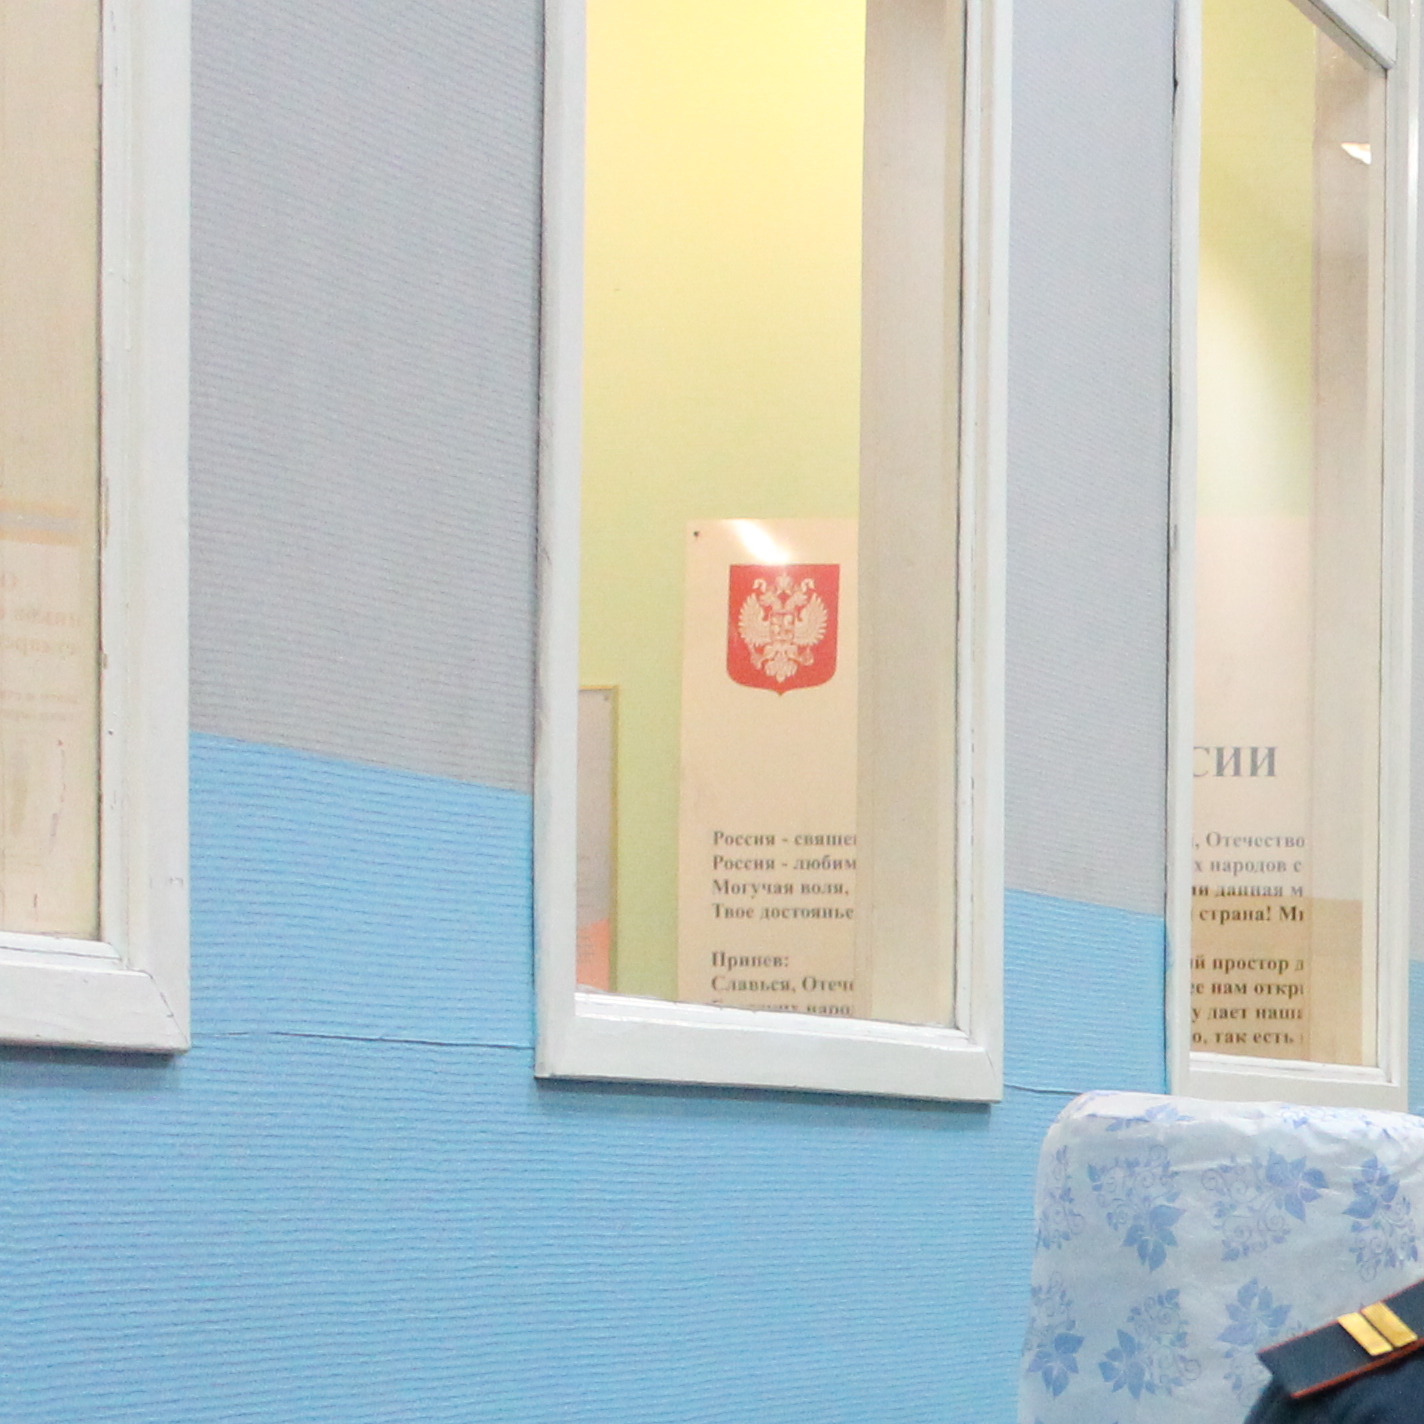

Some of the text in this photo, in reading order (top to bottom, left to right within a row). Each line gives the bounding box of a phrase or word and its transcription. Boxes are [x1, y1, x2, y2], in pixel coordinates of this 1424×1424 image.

[713, 830, 776, 846] Россия
[1205, 831, 1305, 848] Отечество
[713, 855, 775, 871] Россия
[1210, 859, 1287, 876] народов
[712, 879, 850, 899] Могучая воля,
[1215, 884, 1283, 898] данная
[712, 902, 854, 920] Твое достоянье
[1199, 906, 1271, 925] страна!
[712, 951, 789, 971] Припев:
[1213, 958, 1289, 975] простор
[711, 975, 796, 993] Славься,
[1211, 983, 1247, 995] нам
[1208, 1007, 1247, 1020] дает
[1215, 1032, 1248, 1044] так
